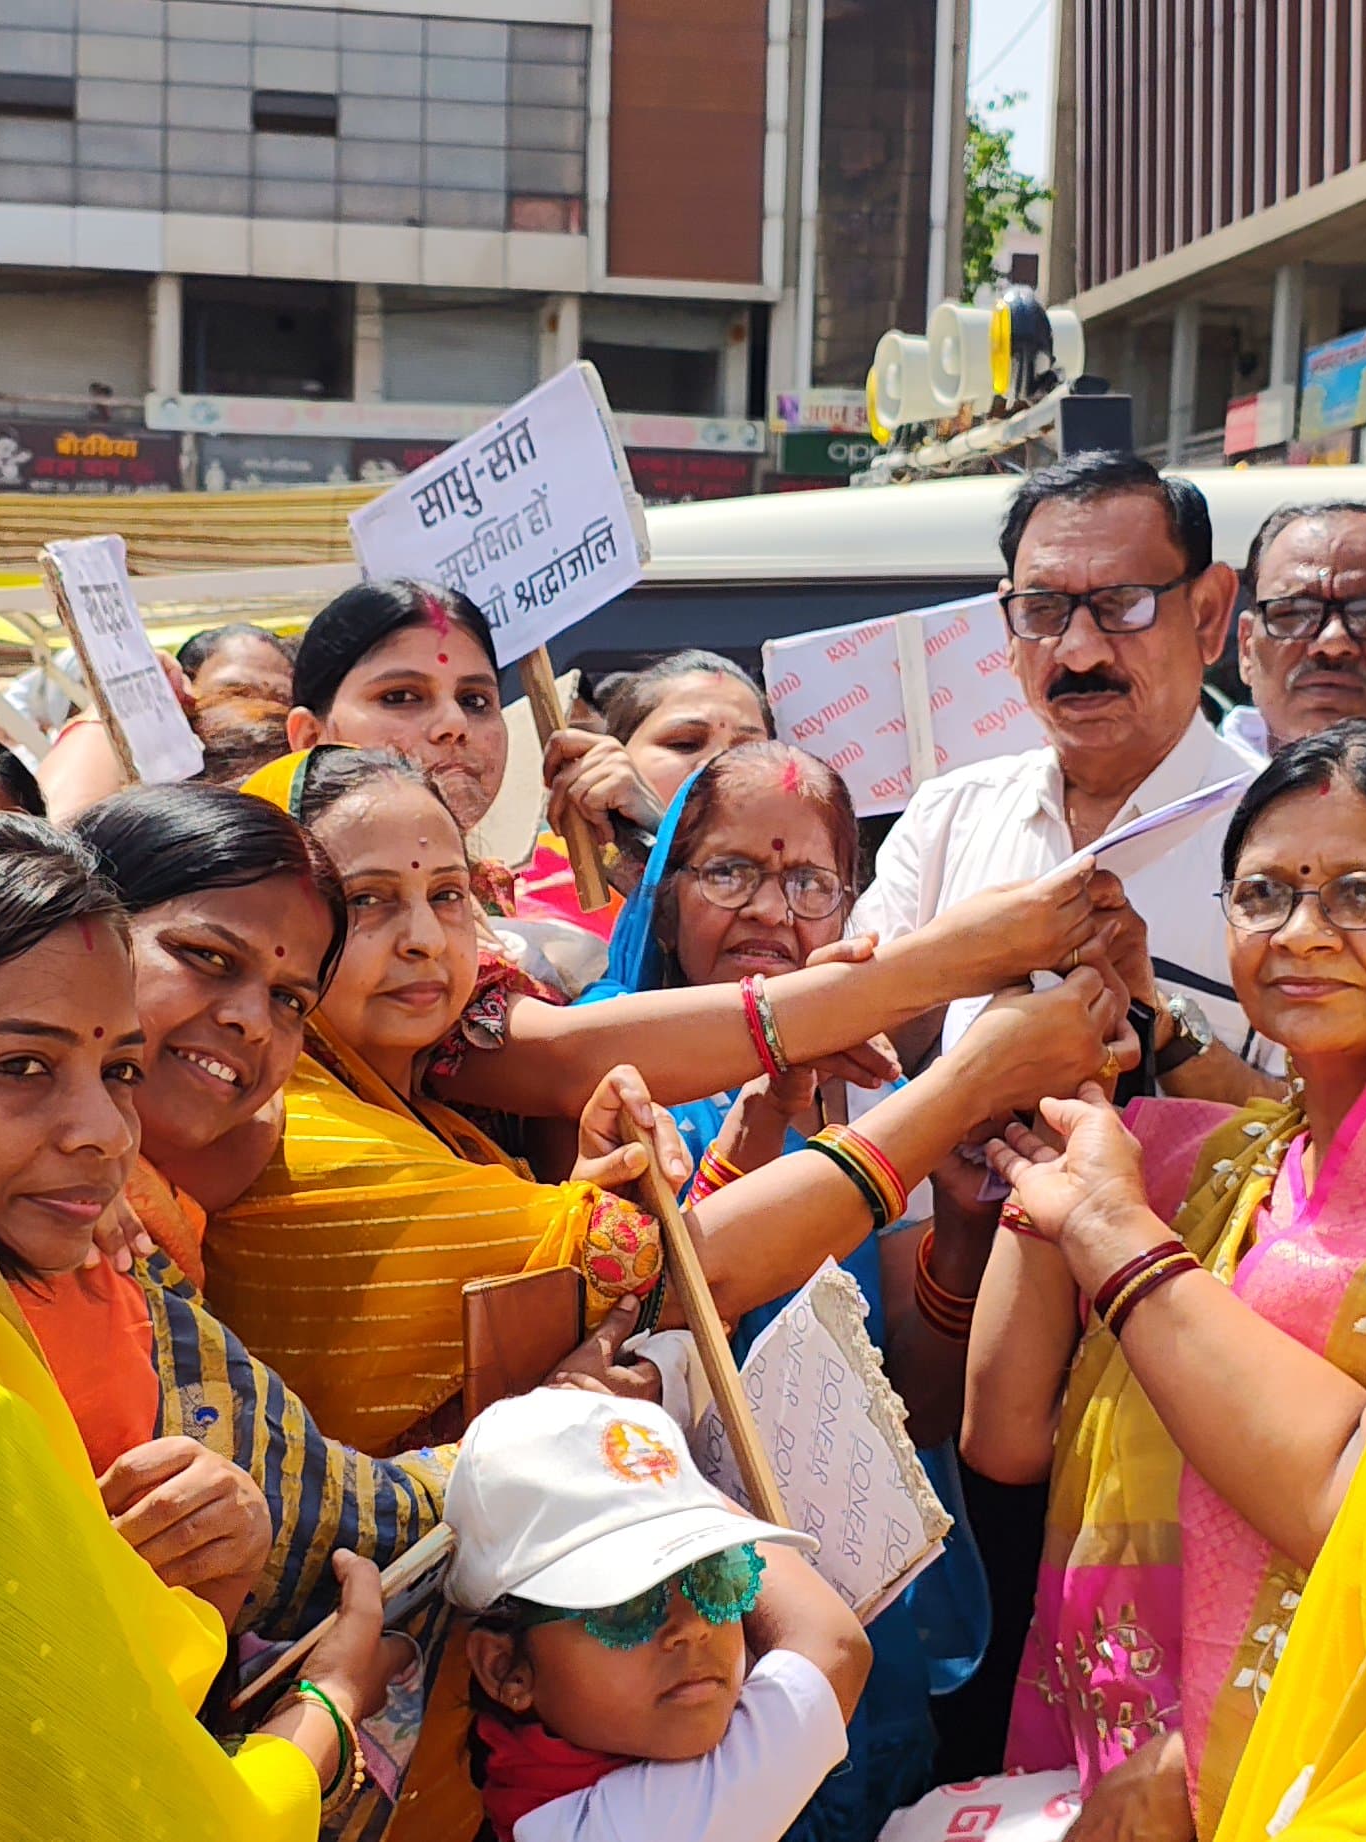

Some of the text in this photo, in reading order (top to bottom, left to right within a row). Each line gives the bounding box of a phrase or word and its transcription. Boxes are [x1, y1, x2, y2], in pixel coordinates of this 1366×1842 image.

[410, 417, 537, 529] साधु-संत
[827, 441, 885, 468] op
[436, 482, 553, 593] सुरक्षित हों
[514, 516, 617, 613] श्रद्धांजलि
[826, 622, 897, 664] Raymo
[791, 684, 871, 743] Raymond
[971, 697, 1032, 738] Raym
[746, 1354, 767, 1413] DON
[784, 1296, 811, 1408] ONEAR
[707, 1412, 725, 1485] DON
[812, 1357, 846, 1487] DONEAR
[775, 1424, 796, 1501] DON
[843, 1436, 874, 1567] DONEAR
